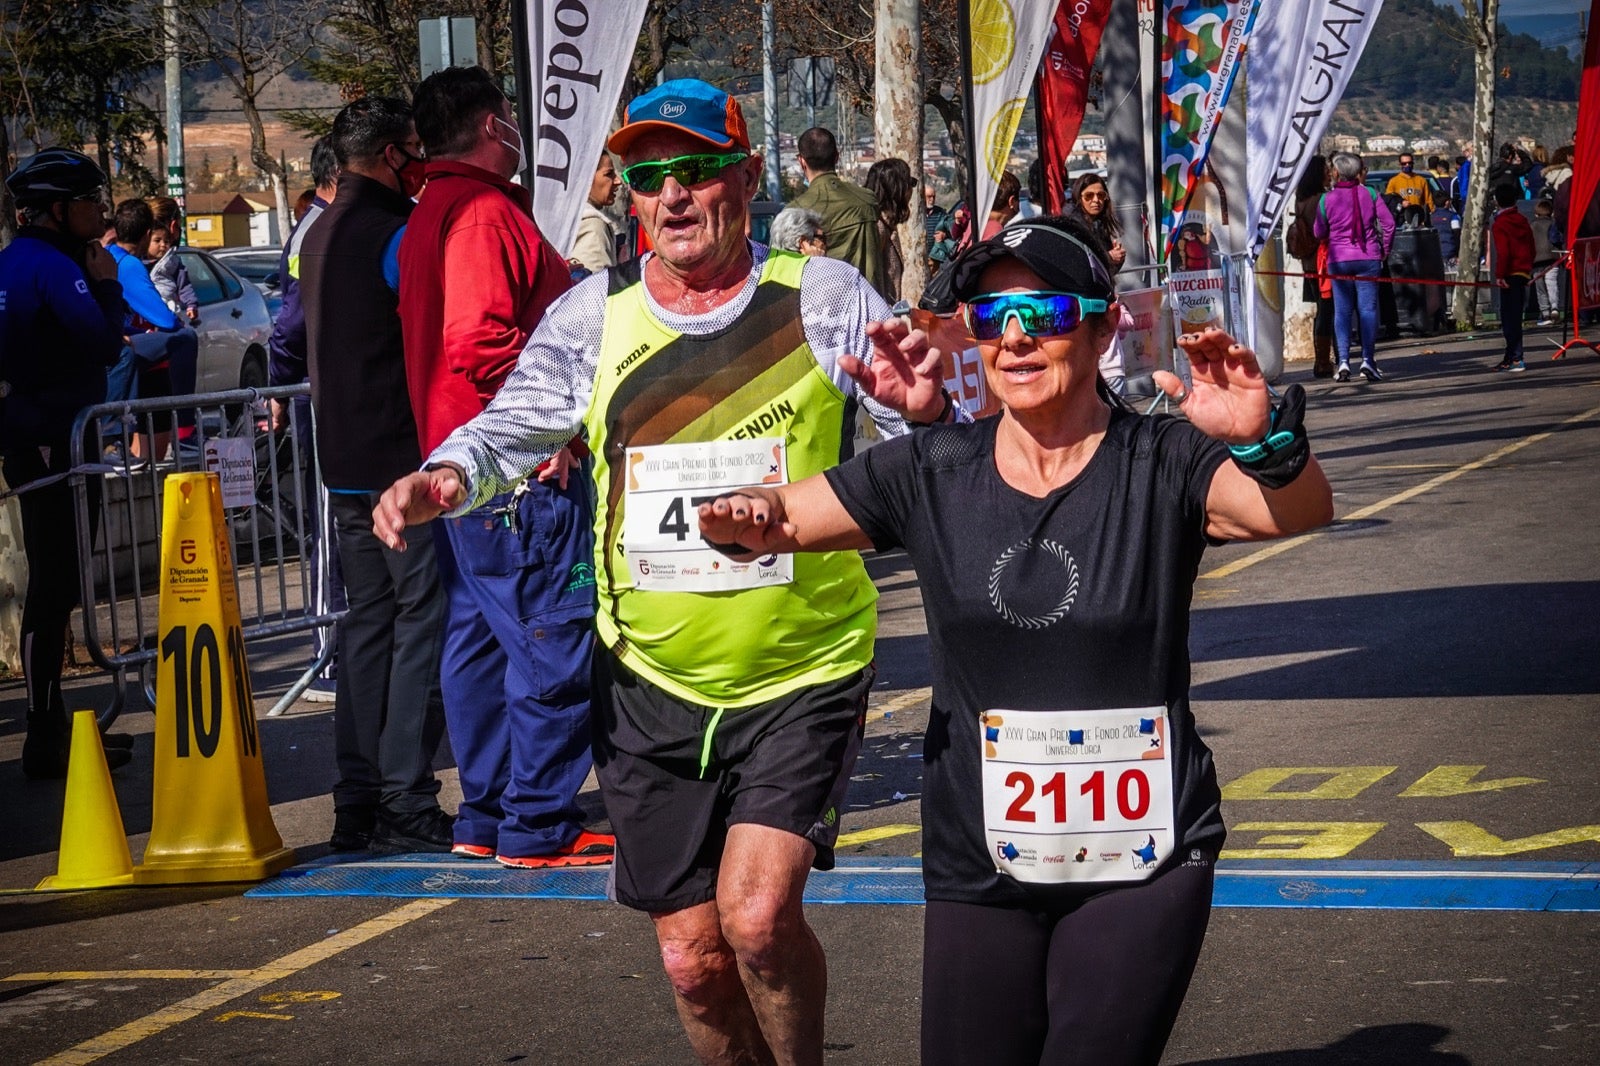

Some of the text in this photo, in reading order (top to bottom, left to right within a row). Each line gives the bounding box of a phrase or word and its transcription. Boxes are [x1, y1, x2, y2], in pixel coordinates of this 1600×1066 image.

[1202, 0, 1251, 135] www.turgranada.es
[537, 0, 603, 191] Depo
[663, 104, 684, 115] Buff
[1179, 295, 1216, 308] Radler
[728, 400, 795, 441] ENDÍN
[170, 568, 208, 576] Diputación
[179, 575, 208, 583] Granada
[162, 623, 222, 758] 10
[227, 625, 257, 757] 10
[1005, 728, 1023, 740] XXXV
[1004, 768, 1150, 823] 2110
